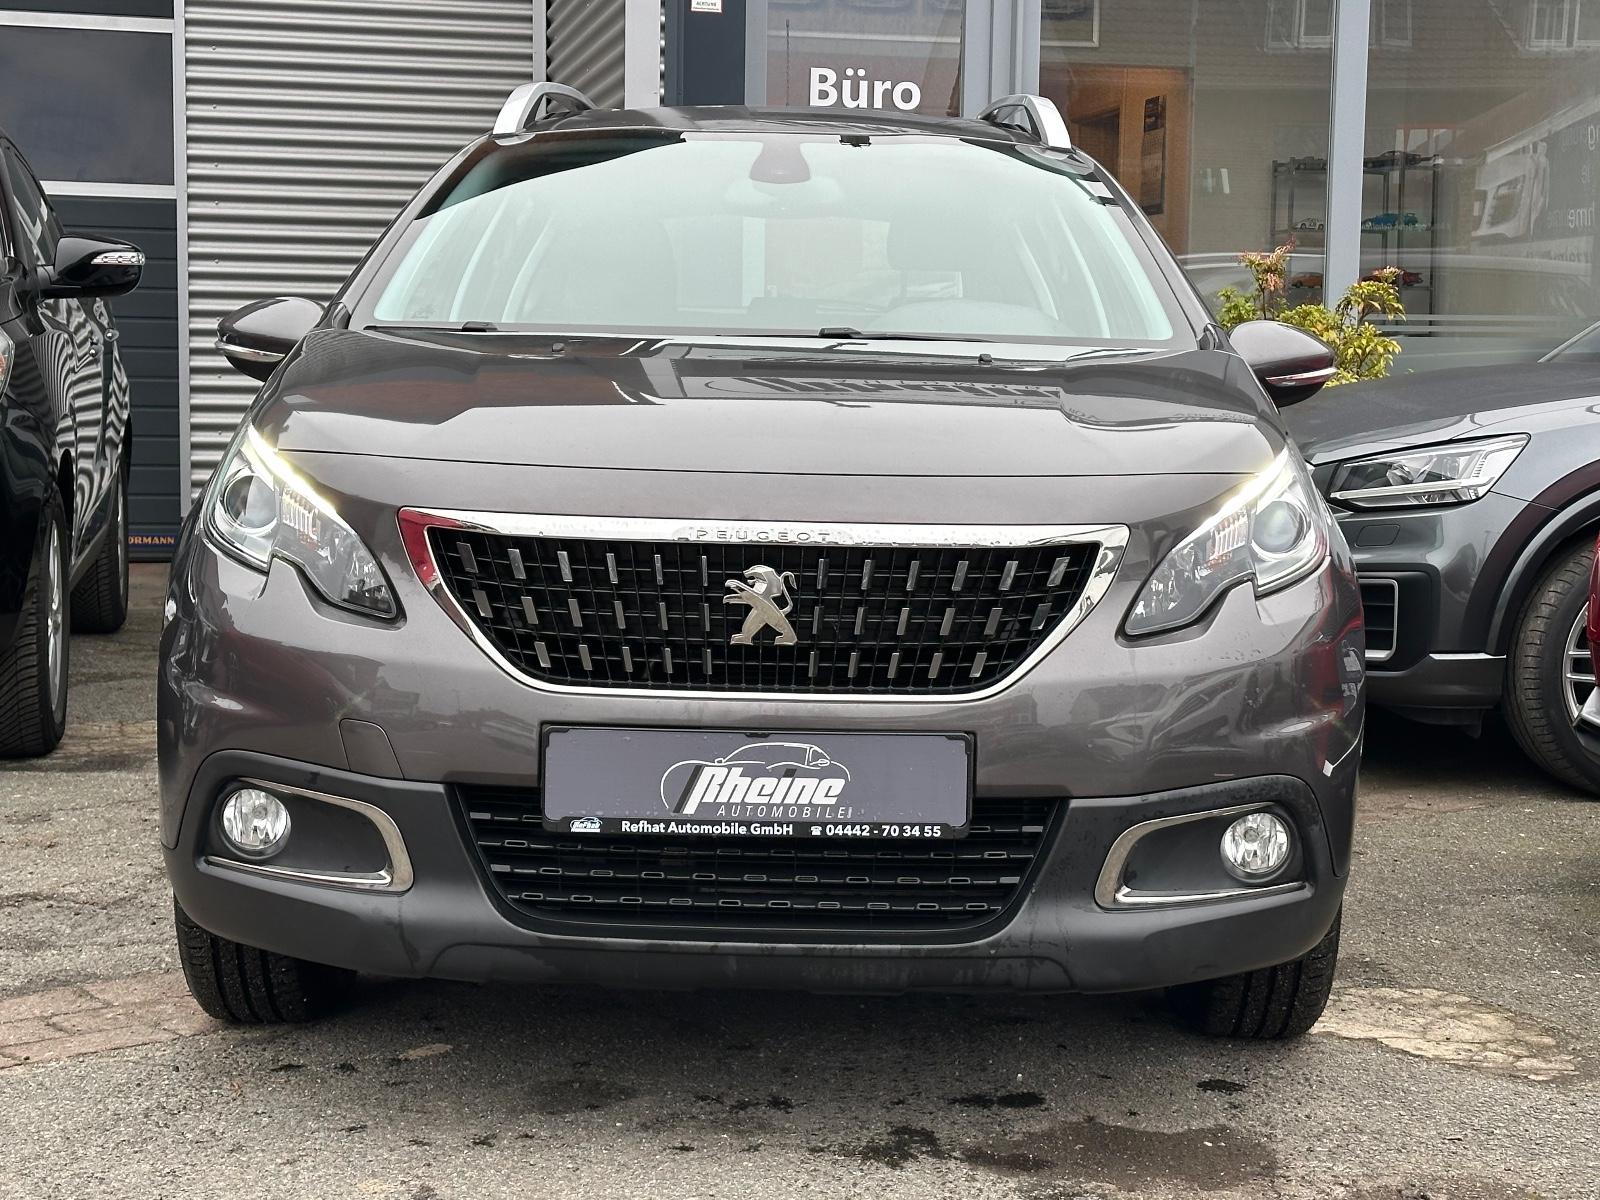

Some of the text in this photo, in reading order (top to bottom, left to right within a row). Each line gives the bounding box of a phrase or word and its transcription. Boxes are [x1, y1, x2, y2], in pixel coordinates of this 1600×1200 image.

[809, 67, 921, 110] Büro
[696, 529, 831, 542] PEUGEOT
[682, 766, 846, 815] Rheine
[621, 820, 665, 833] Refhat
[667, 821, 747, 835] Automobile
[750, 822, 793, 835] GmbH
[825, 824, 870, 836] 04442
[881, 825, 900, 837] 70
[902, 825, 921, 837] 34
[923, 825, 941, 837] 55
